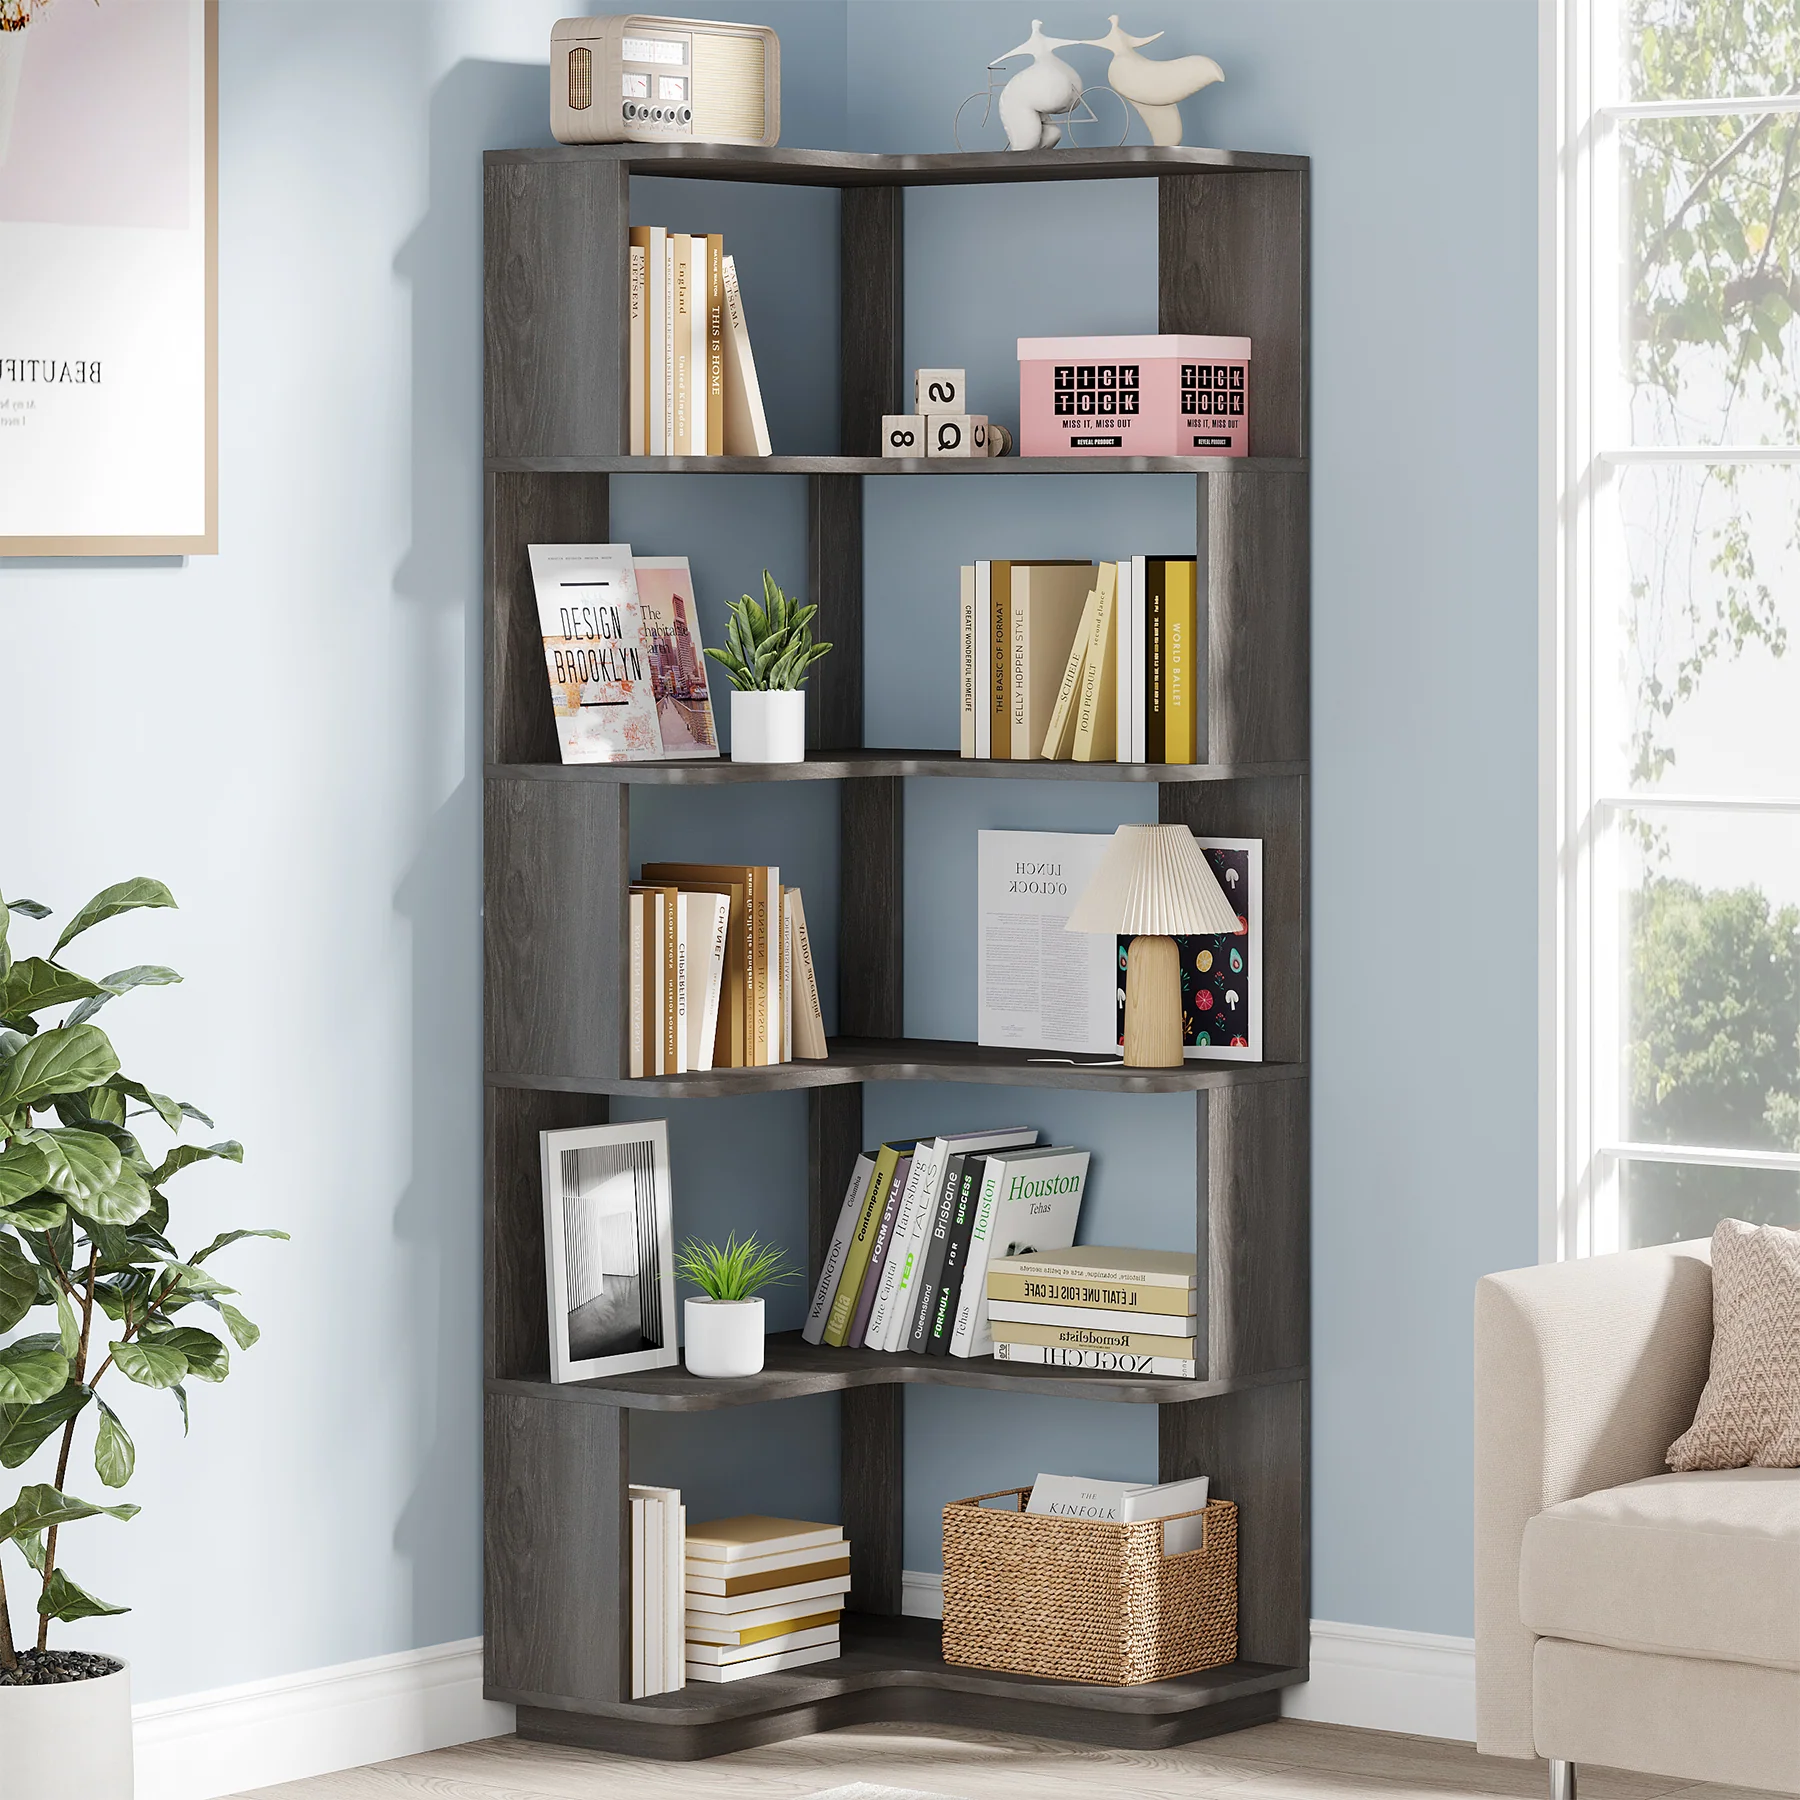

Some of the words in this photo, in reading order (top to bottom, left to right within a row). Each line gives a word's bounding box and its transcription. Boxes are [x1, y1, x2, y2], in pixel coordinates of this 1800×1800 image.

[677, 262, 687, 314] England
[712, 305, 720, 336] THIS
[712, 340, 720, 351] IS
[712, 355, 720, 395] HOME
[1060, 369, 1134, 387] TICK
[1185, 368, 1240, 387] TICK
[677, 392, 686, 437] Kingdom
[1060, 394, 1134, 411] TOCK
[1185, 393, 1240, 412] TOCK
[1062, 419, 1081, 429] MISS
[1083, 419, 1093, 430] IT,
[1095, 418, 1115, 428] MISS
[1117, 418, 1132, 428] OUT
[1187, 419, 1201, 428] MISS
[1212, 419, 1226, 428] MISS
[1227, 419, 1239, 429] OUT
[560, 606, 623, 641] DESIGN
[640, 604, 661, 620] The
[996, 602, 1004, 643] FORMAT
[1015, 609, 1024, 641] STYLE
[1093, 618, 1102, 646] second
[1172, 622, 1181, 663] WORLD
[554, 647, 642, 684] BROOKLYN
[996, 646, 1004, 660] OF
[1015, 645, 1024, 689] HOPPEN
[996, 662, 1004, 692] BASIC
[1060, 652, 1080, 703] SCHIELE
[1084, 662, 1097, 707] PICOULT
[1172, 667, 1181, 707] BALLET
[996, 694, 1004, 714] THE
[1015, 691, 1024, 725] KELLY
[1080, 709, 1091, 733] JODI
[1007, 1173, 1080, 1201] Houston
[871, 1223, 888, 1264] FORM
[884, 1178, 901, 1222] STYLE
[974, 1179, 996, 1241] Houston
[811, 1238, 843, 1319] WASHINGTON
[847, 1175, 862, 1208] Columbia
[871, 1304, 886, 1334] State
[880, 1260, 897, 1301] Capital
[895, 1159, 927, 1238] Harrisburg
[914, 1283, 932, 1339] Queensland
[934, 1171, 958, 1240] Brisbane
[933, 1287, 950, 1338] FORMULA
[948, 1242, 959, 1266] FOR
[956, 1174, 972, 1225] SUCCESS
[899, 1252, 915, 1290] TED
[827, 1293, 851, 1335] Italia
[1049, 1502, 1116, 1520] KINFOLK
[1080, 1492, 1097, 1500] THE
